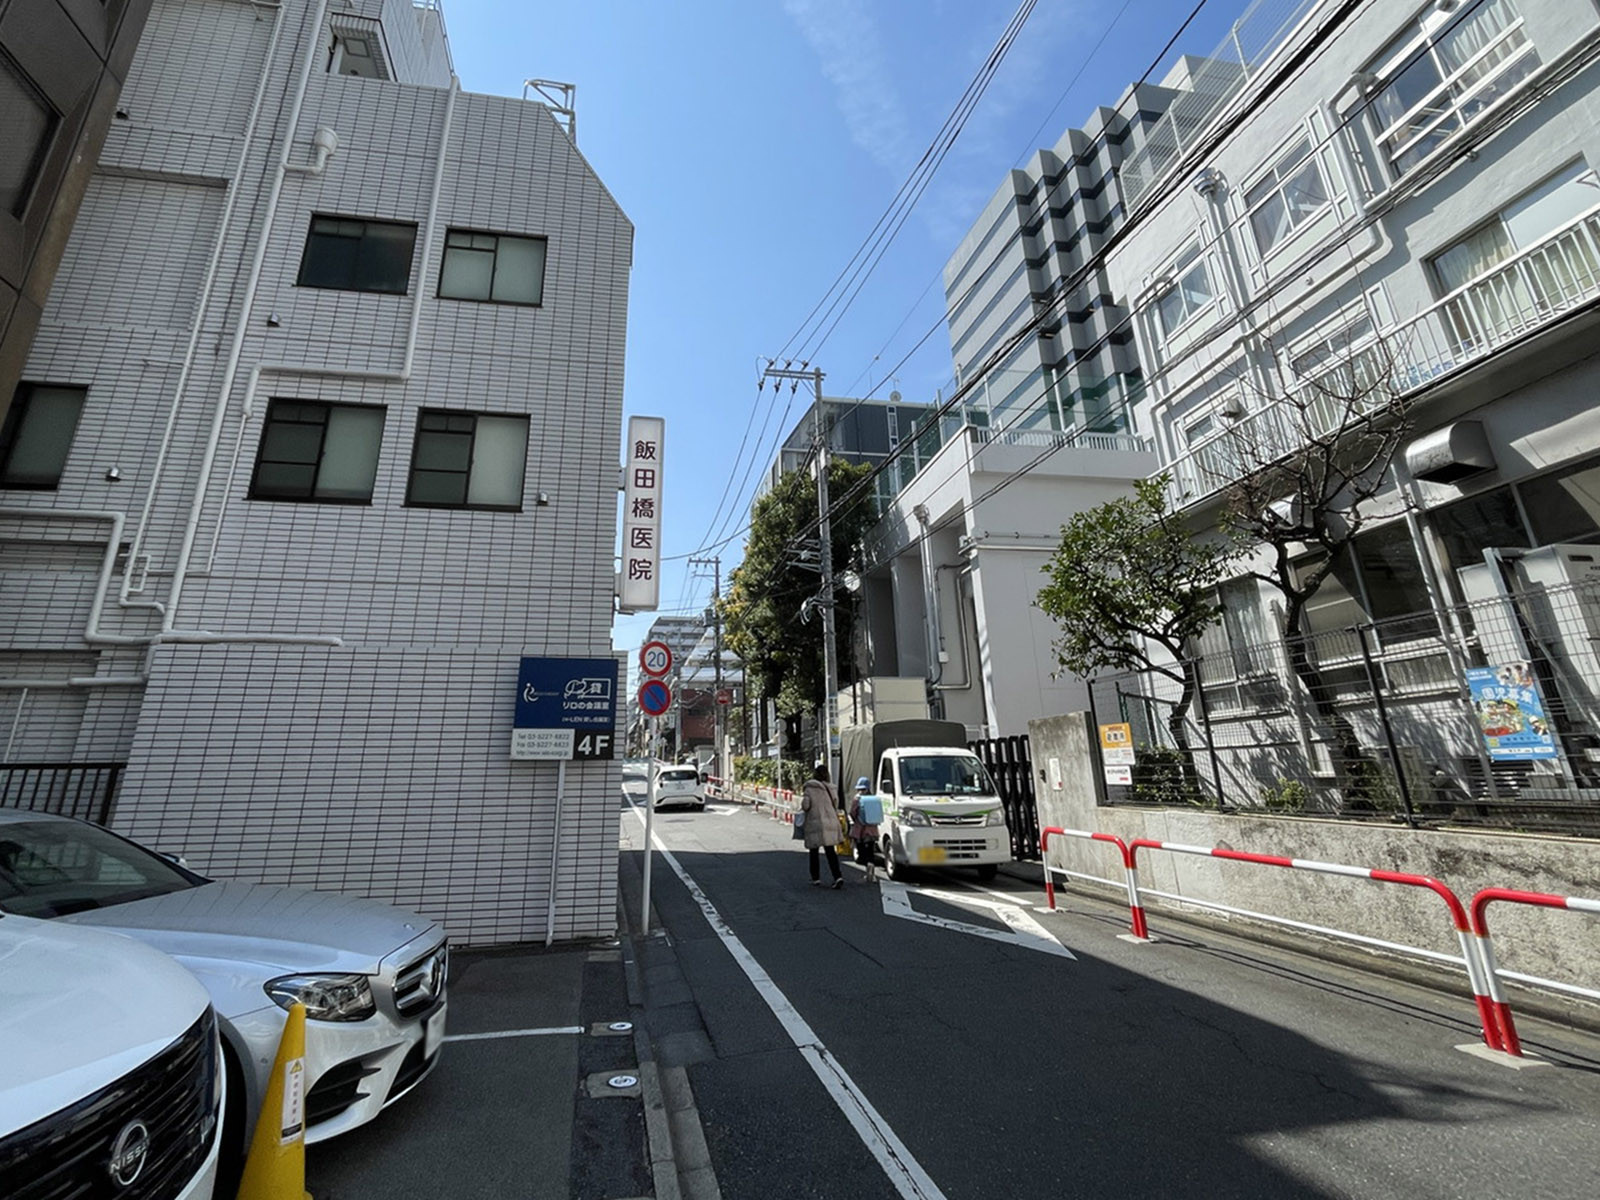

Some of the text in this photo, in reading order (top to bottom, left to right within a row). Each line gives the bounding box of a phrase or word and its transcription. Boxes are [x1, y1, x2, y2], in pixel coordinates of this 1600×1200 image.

[628, 440, 656, 580] 飯田橋医院
[647, 651, 666, 667] 20
[577, 734, 610, 755] 4F
